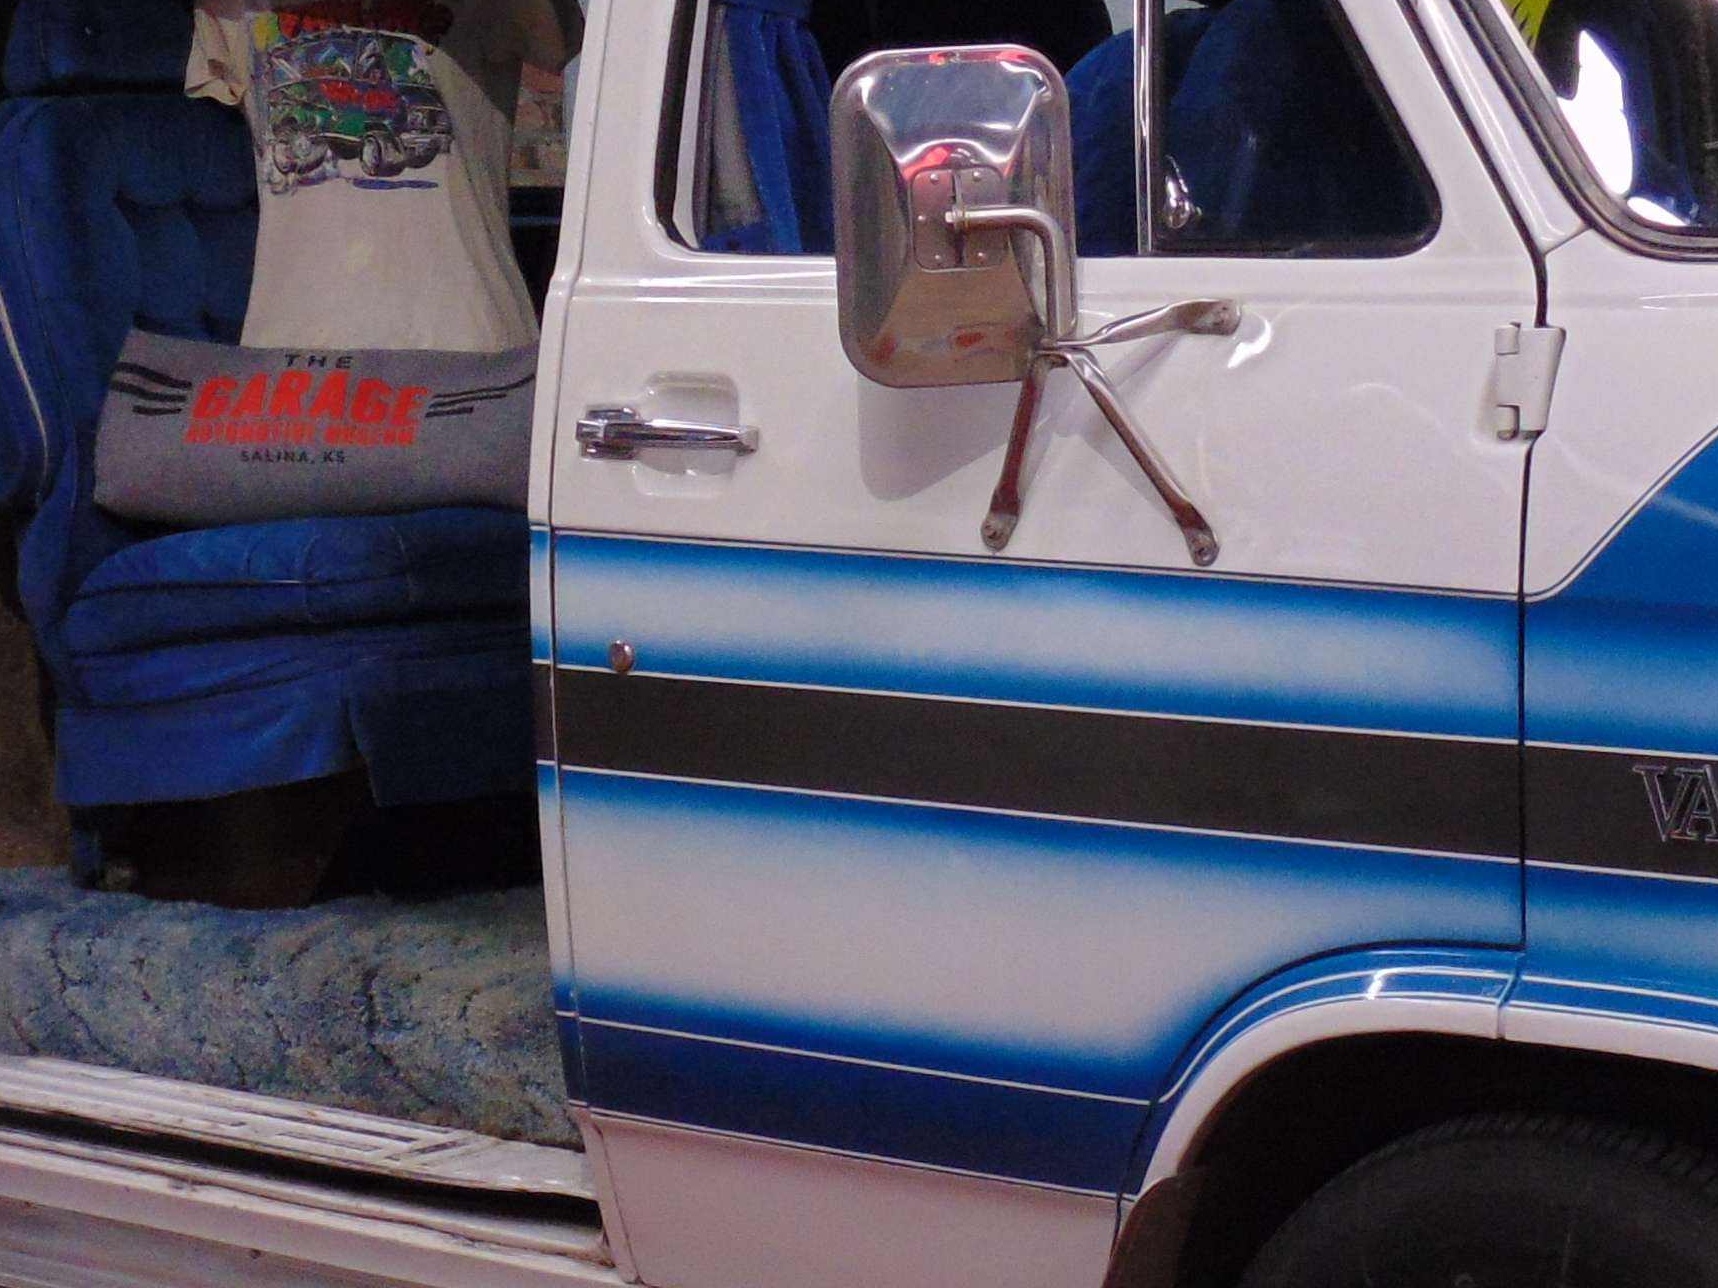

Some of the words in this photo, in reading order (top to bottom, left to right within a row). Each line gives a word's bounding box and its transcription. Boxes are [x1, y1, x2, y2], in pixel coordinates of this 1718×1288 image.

[284, 353, 355, 369] THE
[192, 368, 429, 425] GARAGE
[185, 420, 317, 446] AUTOMOTIVE
[323, 422, 419, 448] MUSEUM
[240, 449, 316, 465] SALINA,
[323, 449, 347, 464] KS
